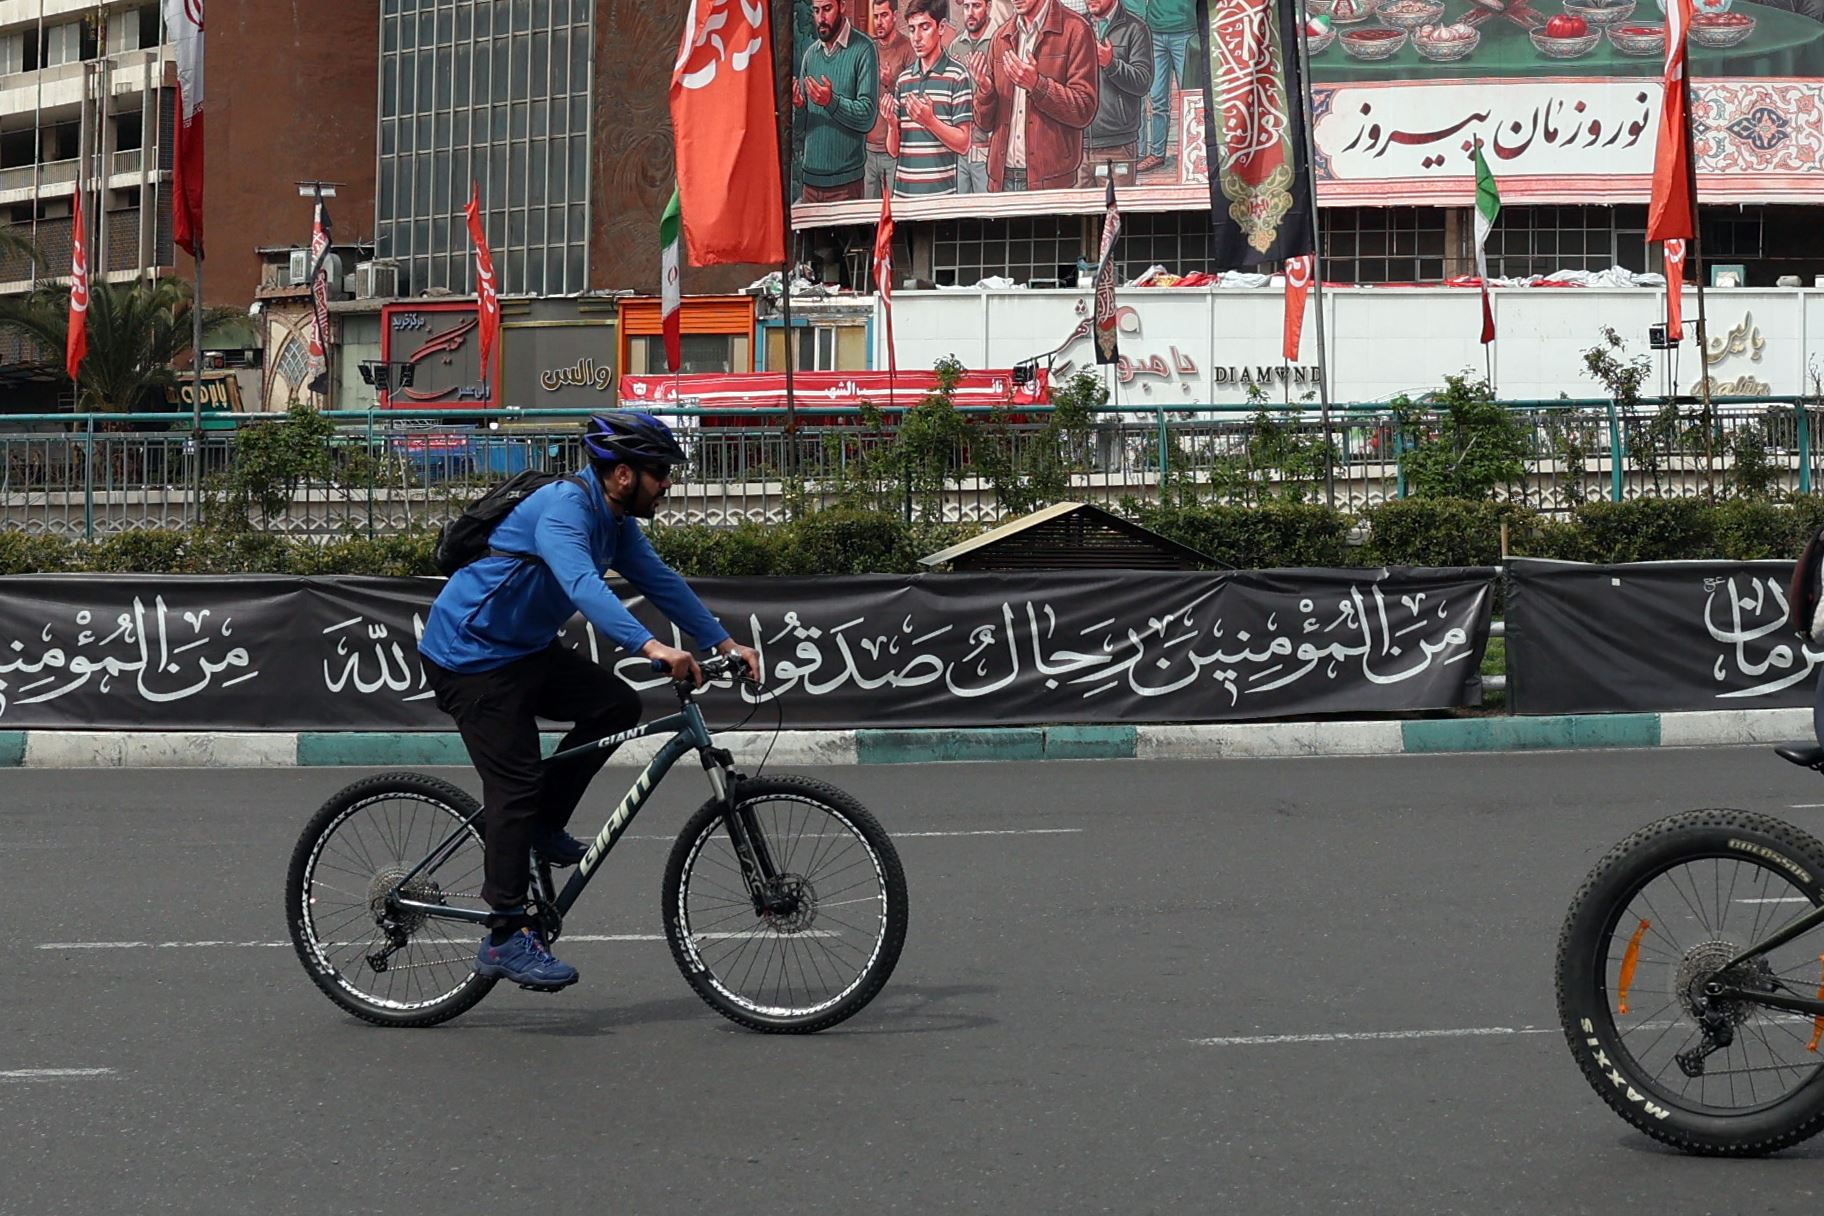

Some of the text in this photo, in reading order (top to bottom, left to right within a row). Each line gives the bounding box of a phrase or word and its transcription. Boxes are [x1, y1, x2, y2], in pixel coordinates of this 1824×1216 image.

[1341, 102, 1492, 169] پیروز
[541, 358, 612, 391] والس
[598, 724, 649, 748] GIANT
[579, 759, 653, 877] GIANT
[1580, 1017, 1671, 1120] MAXXIS
